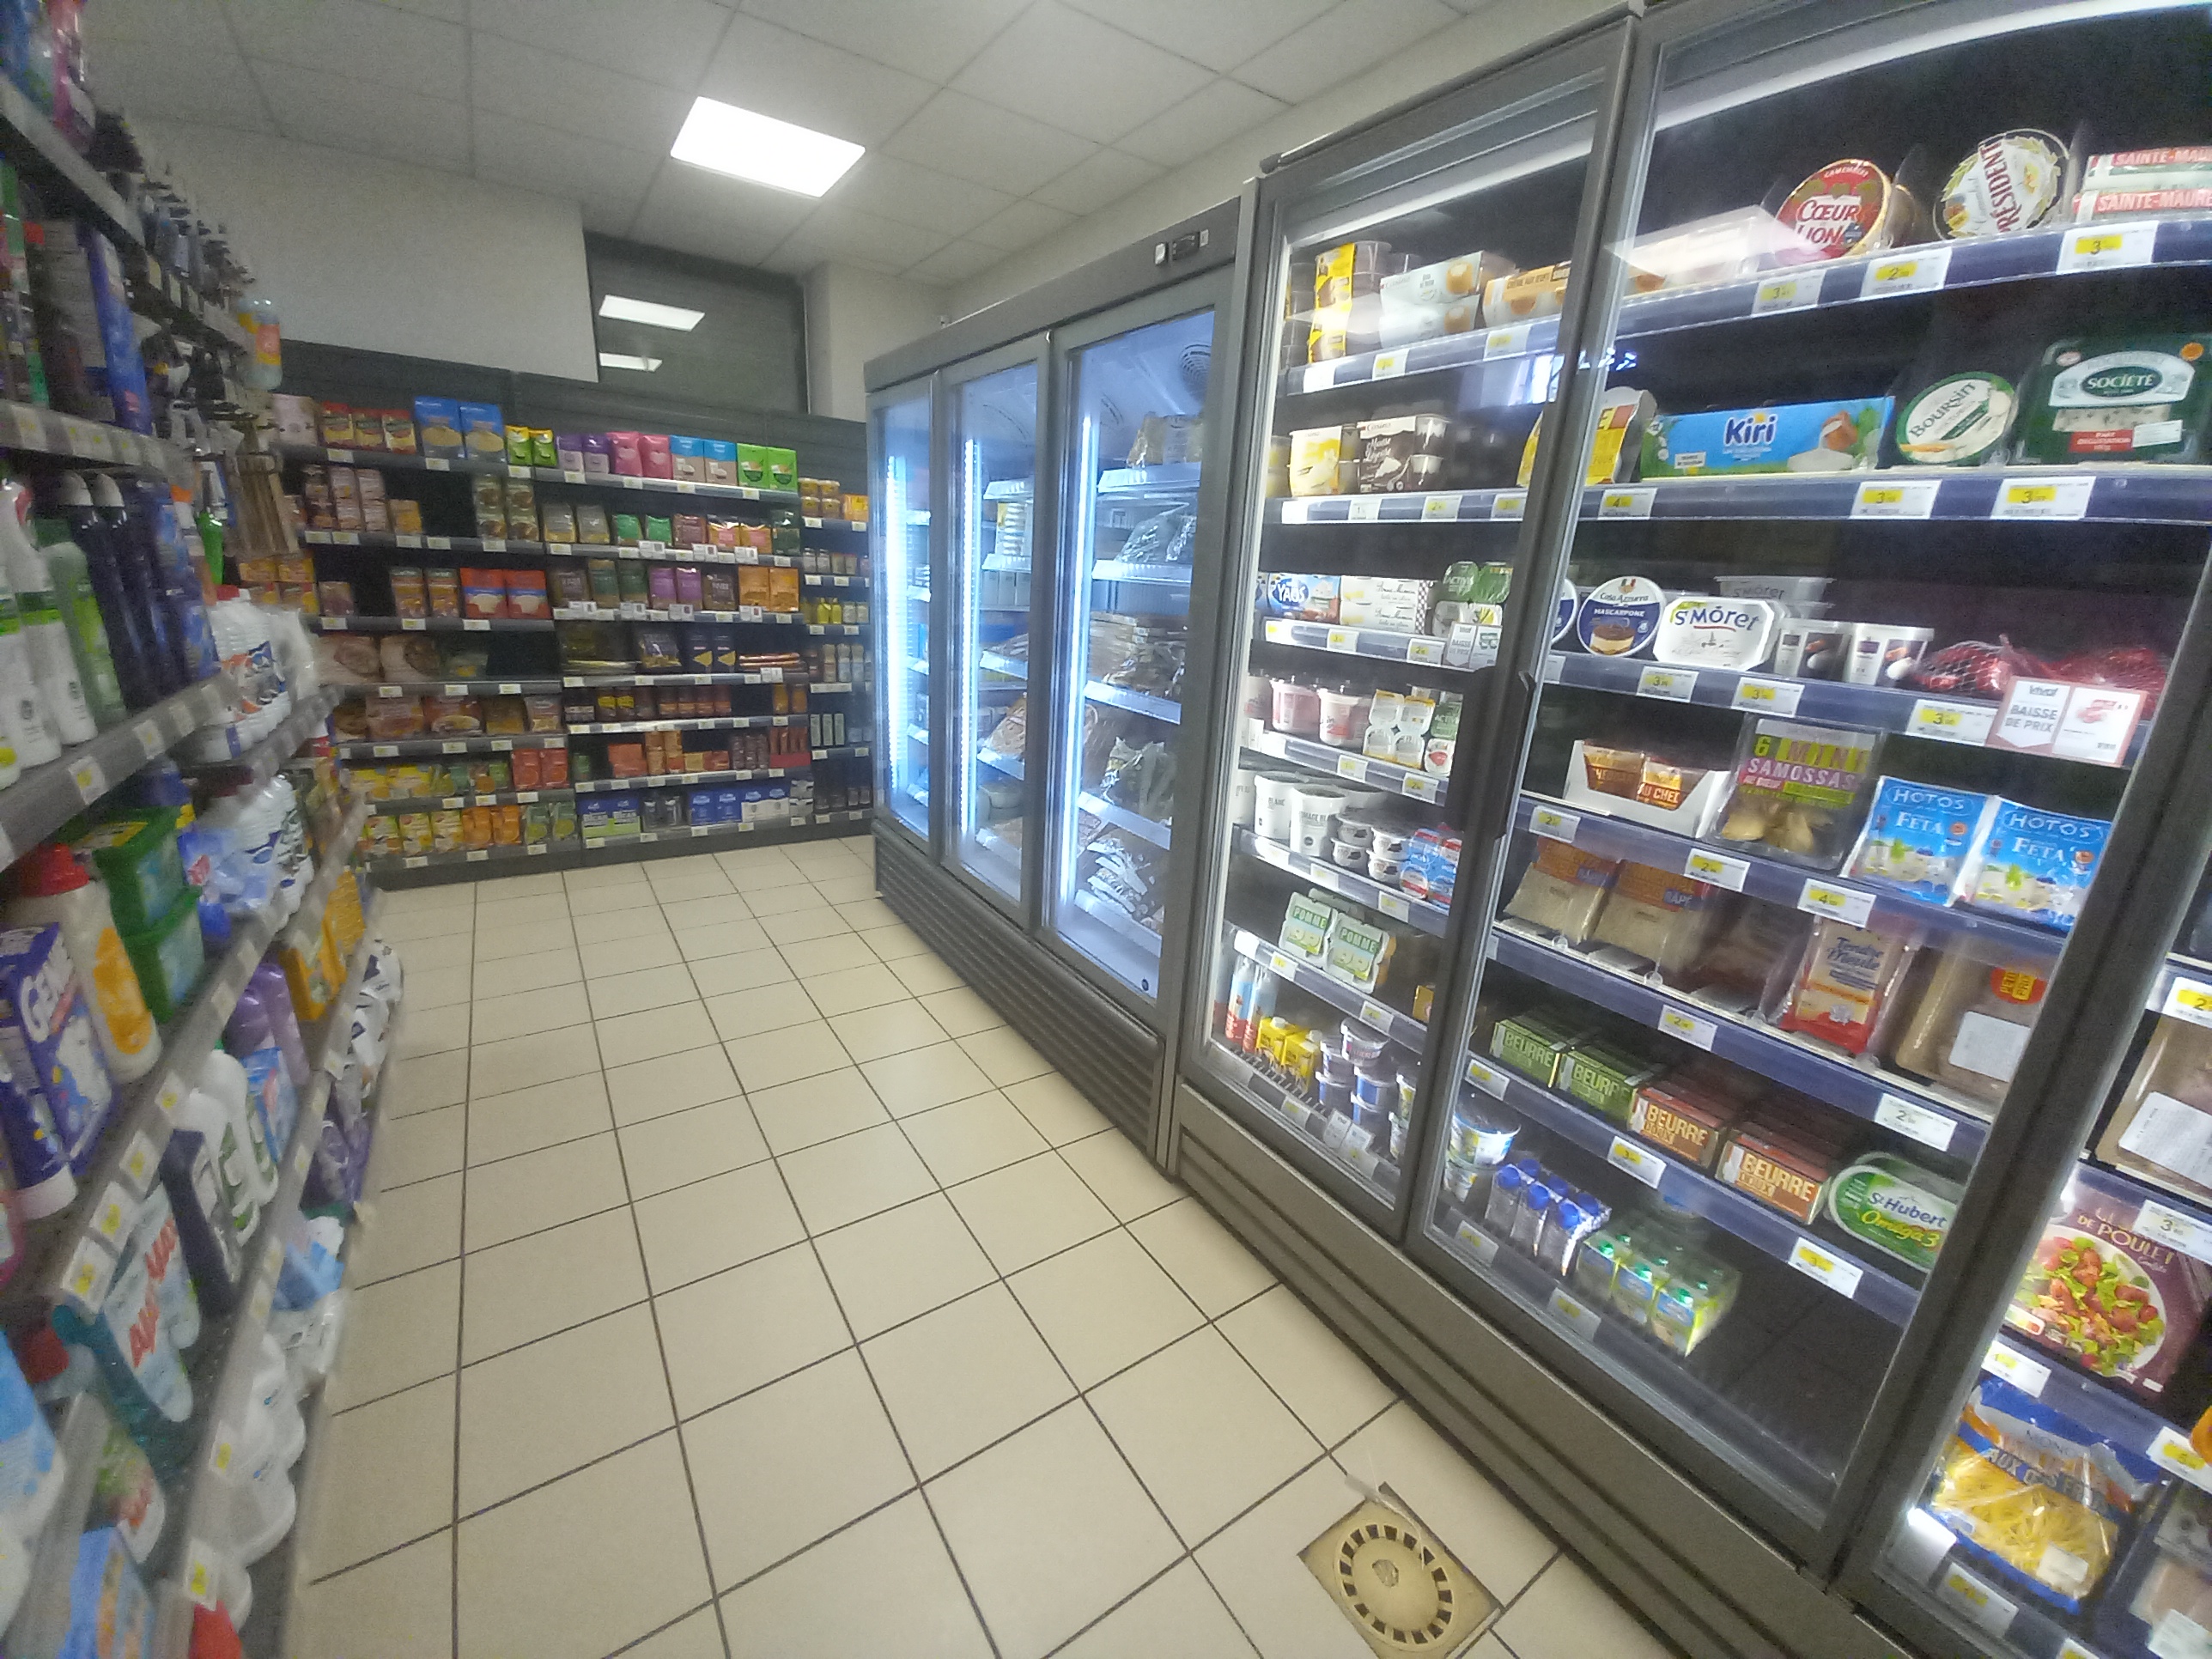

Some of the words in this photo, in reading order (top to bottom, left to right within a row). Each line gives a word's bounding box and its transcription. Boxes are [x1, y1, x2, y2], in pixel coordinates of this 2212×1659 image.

[1724, 414, 1778, 446] Kiri
[1278, 581, 1306, 602] YAOS
[2005, 717, 2021, 728] DE
[2023, 720, 2054, 732] PRIX
[2010, 704, 2058, 720] BAISSE
[1754, 735, 1771, 757] 6
[1747, 757, 1856, 791] SAMOSSAS
[1893, 787, 1965, 811] HOTOS
[1895, 811, 1945, 836] FETA
[2009, 812, 2091, 838] HOTOS
[2011, 836, 2064, 862] FETA
[1292, 906, 1328, 929] POMME
[1339, 927, 1377, 952] POMME
[1504, 1030, 1555, 1068] BEURRE
[1647, 1103, 1709, 1146] BEURRE
[1743, 1152, 1816, 1202] BEURRE
[1884, 1198, 1948, 1228] Hubert
[2078, 1214, 2096, 1229] DE
[2097, 1222, 2175, 1265] POULET
